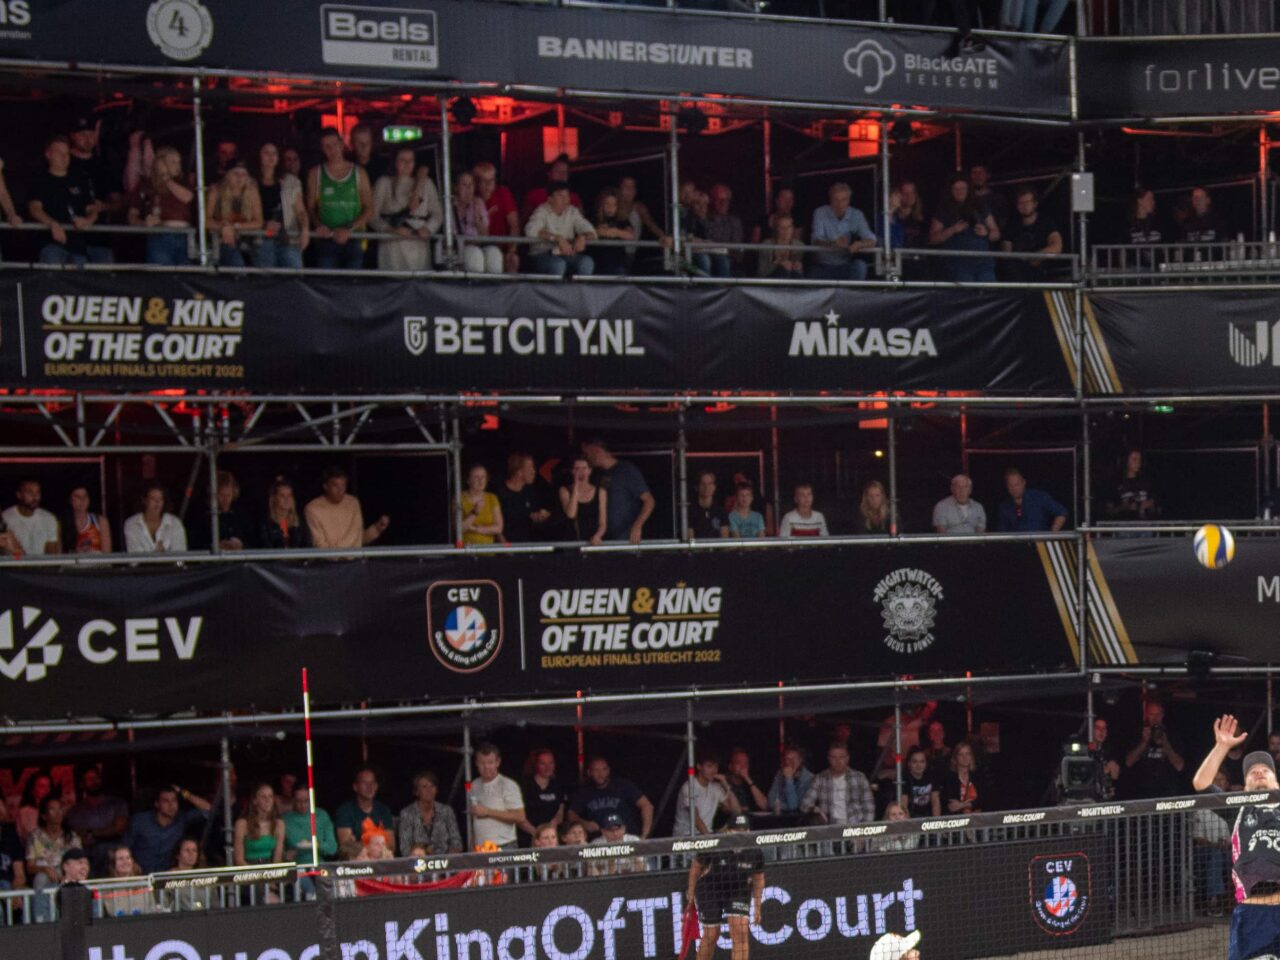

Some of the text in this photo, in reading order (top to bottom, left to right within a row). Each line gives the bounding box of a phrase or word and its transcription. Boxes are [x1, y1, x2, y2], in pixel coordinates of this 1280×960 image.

[328, 12, 429, 41] Boels
[392, 48, 431, 62] RENTAL
[537, 36, 753, 68] BANNERSTUNTER
[905, 74, 998, 89] TELECOM
[41, 295, 244, 327] QUEEN & KING
[44, 332, 241, 361] OF THE COURT
[434, 316, 645, 355] BETCITY.NL
[44, 364, 244, 378] EUROPEAN FINALS UTRECHT 2022
[873, 567, 943, 599] NIGHTWATCH
[447, 588, 481, 602] CEV
[540, 586, 722, 618] QUEEN & KING
[78, 616, 203, 664] CEV
[541, 620, 720, 652] OF THE COURT
[541, 650, 720, 668] EUROPEAN FINALS UTRECHT 2022
[582, 846, 630, 858] NIGHTWATCH
[344, 866, 374, 876] Senoh
[427, 859, 449, 870] CEV
[1045, 860, 1073, 873] CEV
